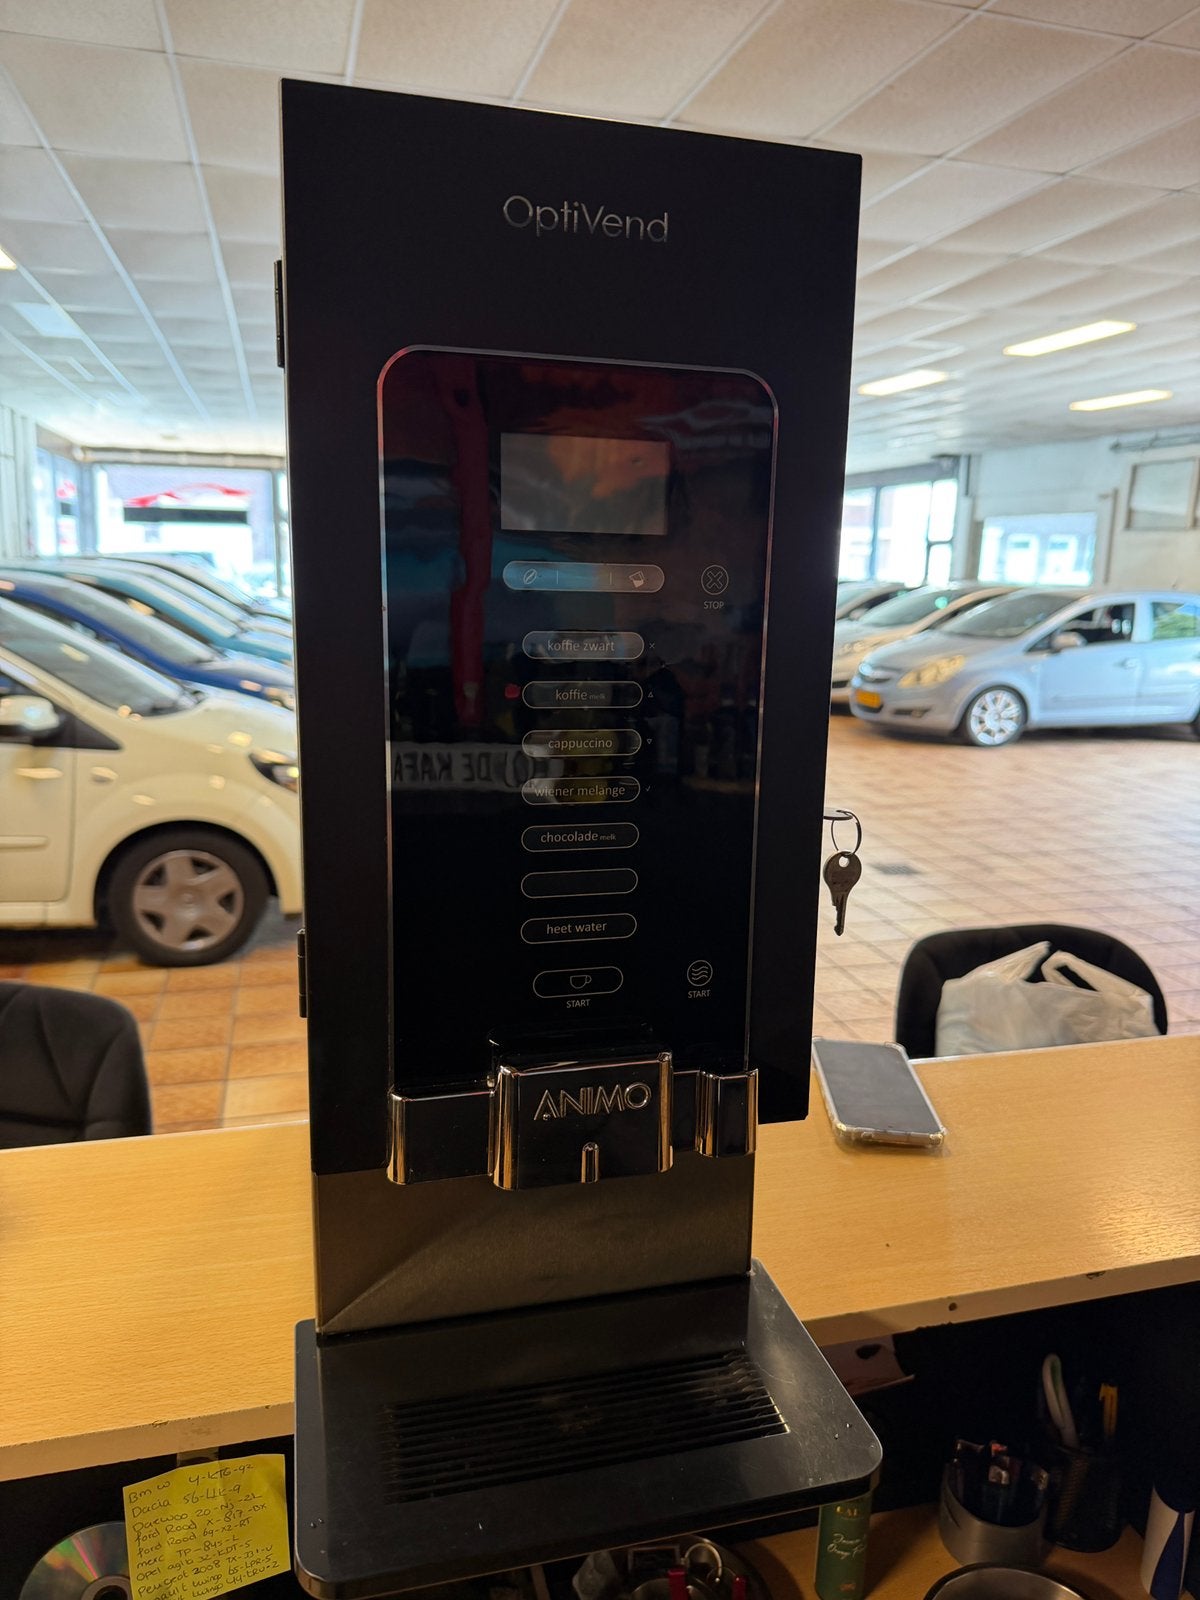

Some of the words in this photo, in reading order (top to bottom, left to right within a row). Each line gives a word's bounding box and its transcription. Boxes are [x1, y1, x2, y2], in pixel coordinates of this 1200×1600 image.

[503, 195, 669, 243] OptiVend
[703, 600, 725, 610] STOP
[548, 639, 582, 652] koffie
[583, 640, 615, 652] zwart
[555, 688, 588, 701] koffie
[548, 737, 613, 750] cappuccino
[534, 785, 575, 798] wiener
[577, 783, 626, 798] melange
[540, 831, 599, 844] chocolade
[600, 833, 617, 842] melk
[546, 923, 572, 935] heet
[574, 921, 608, 933] water
[687, 989, 712, 999] START
[566, 998, 591, 1009] START
[533, 1081, 653, 1121] ANIMO
[131, 1500, 171, 1518] Dacia
[192, 1559, 220, 1575] 2008
